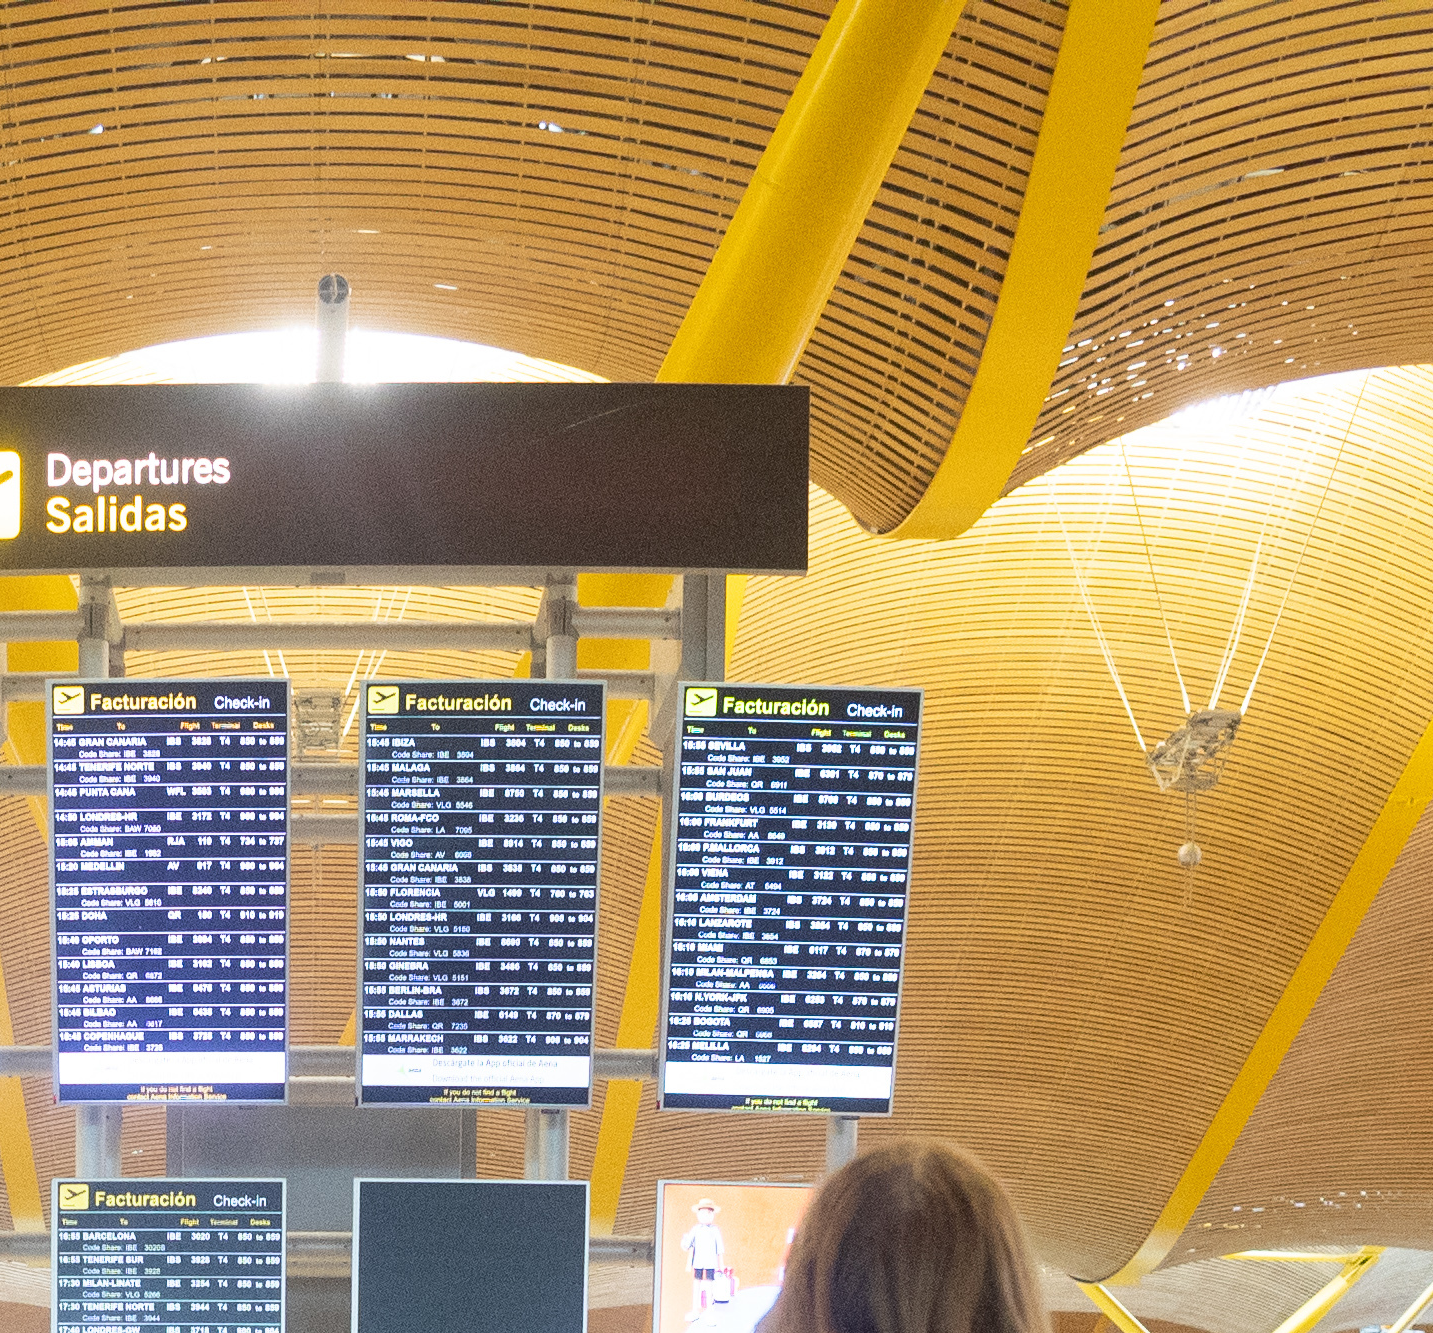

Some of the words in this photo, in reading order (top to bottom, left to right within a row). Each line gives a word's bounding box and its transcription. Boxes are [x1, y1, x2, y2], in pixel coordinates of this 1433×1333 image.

[45, 452, 231, 490] Departures
[45, 497, 188, 534] Salidas
[90, 692, 197, 711] Facturación
[214, 696, 271, 709] Check-in
[405, 694, 512, 711] Facturación
[529, 698, 586, 712] Check-in
[723, 696, 830, 715] Facturación
[847, 703, 903, 718] Check-in
[392, 739, 415, 747] IBIZA
[534, 739, 545, 747] T4
[392, 764, 430, 772] MALAGA
[390, 839, 413, 847] VIGO
[390, 864, 417, 872] GRAN
[418, 864, 458, 872] CANARIA
[95, 1191, 196, 1207] Facturación
[213, 1195, 267, 1207] Check-in
[83, 1232, 136, 1240] BARCELONA
